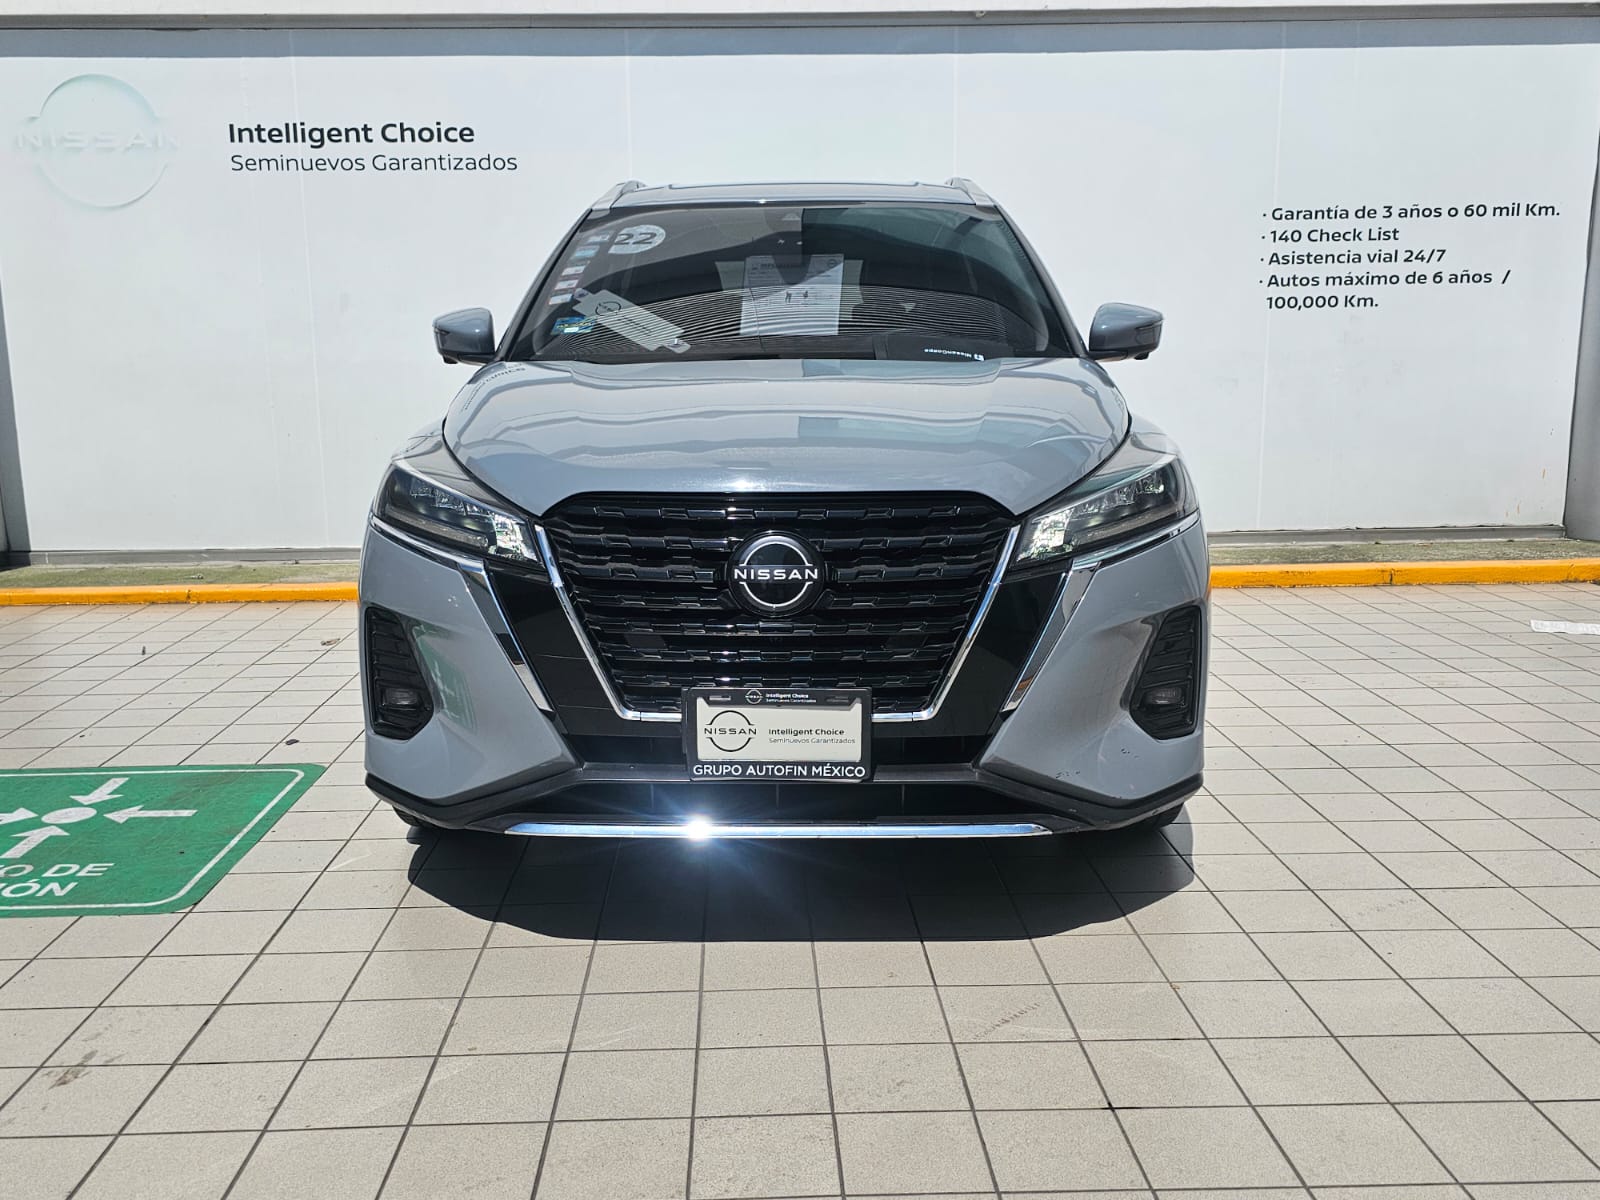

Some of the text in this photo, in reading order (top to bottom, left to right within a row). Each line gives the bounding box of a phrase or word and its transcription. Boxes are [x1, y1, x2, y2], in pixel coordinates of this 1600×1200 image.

[14, 127, 179, 151] NISSAN
[228, 121, 475, 150] Intelligent Choice
[230, 153, 518, 172] Seminuevos Garantizados
[1271, 202, 1560, 221] Garantía de 3 años o 60 mil Km.
[613, 231, 658, 246] 22
[1270, 226, 1400, 244] 140 Check List
[1268, 248, 1447, 266] Asistencia vial 24/7
[1267, 273, 1320, 288] Autos
[1325, 271, 1400, 287] máximo
[1404, 270, 1428, 285] de
[1432, 271, 1444, 285] 6
[1448, 269, 1493, 284] años
[1266, 294, 1379, 311] 100,000 Km.
[733, 568, 818, 580] NISSAN
[704, 727, 757, 735] NISSAN
[768, 728, 845, 737] Intelligent Choice
[692, 763, 866, 778] GRUPO AUTOFIN MÉXICO
[41, 862, 115, 878] DE
